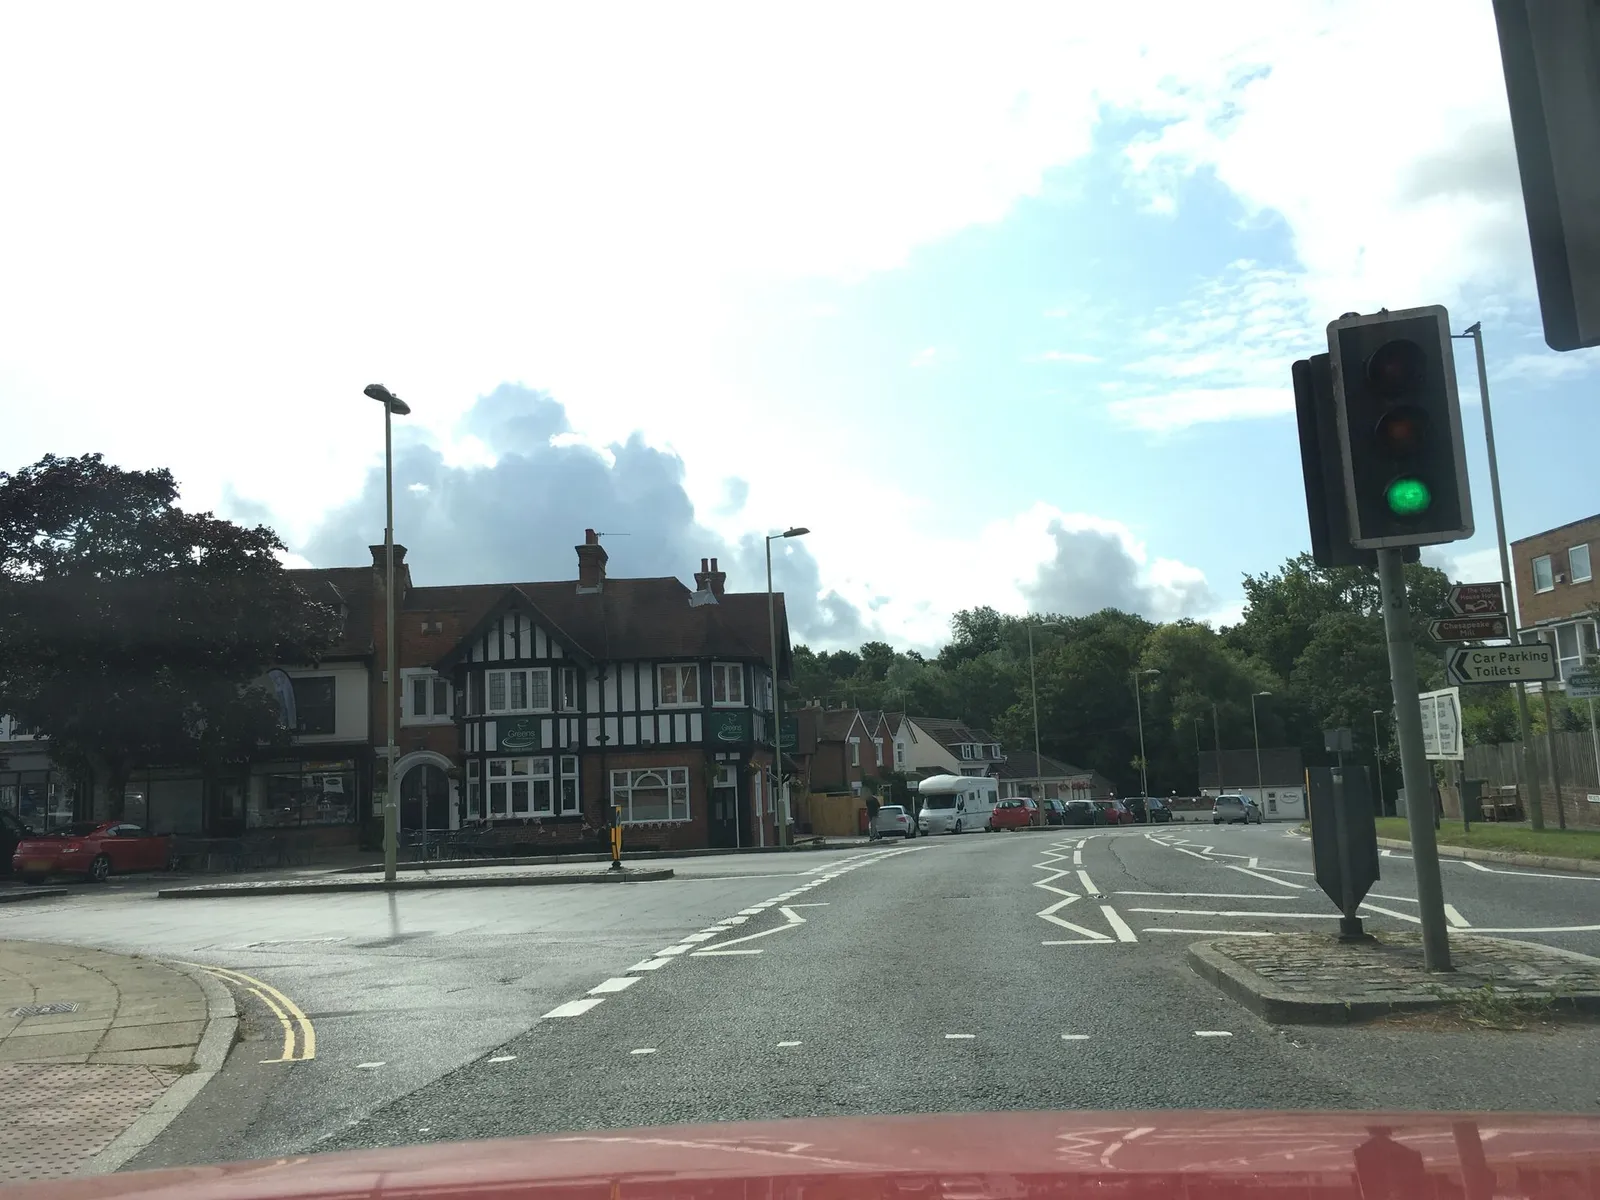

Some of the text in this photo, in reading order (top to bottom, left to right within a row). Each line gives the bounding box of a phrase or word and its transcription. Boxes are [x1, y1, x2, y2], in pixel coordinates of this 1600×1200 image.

[1443, 620, 1490, 630] Chesapeake
[1472, 651, 1549, 664] Car Parking
[1474, 665, 1521, 677] Toilets
[508, 729, 536, 738] Greens
